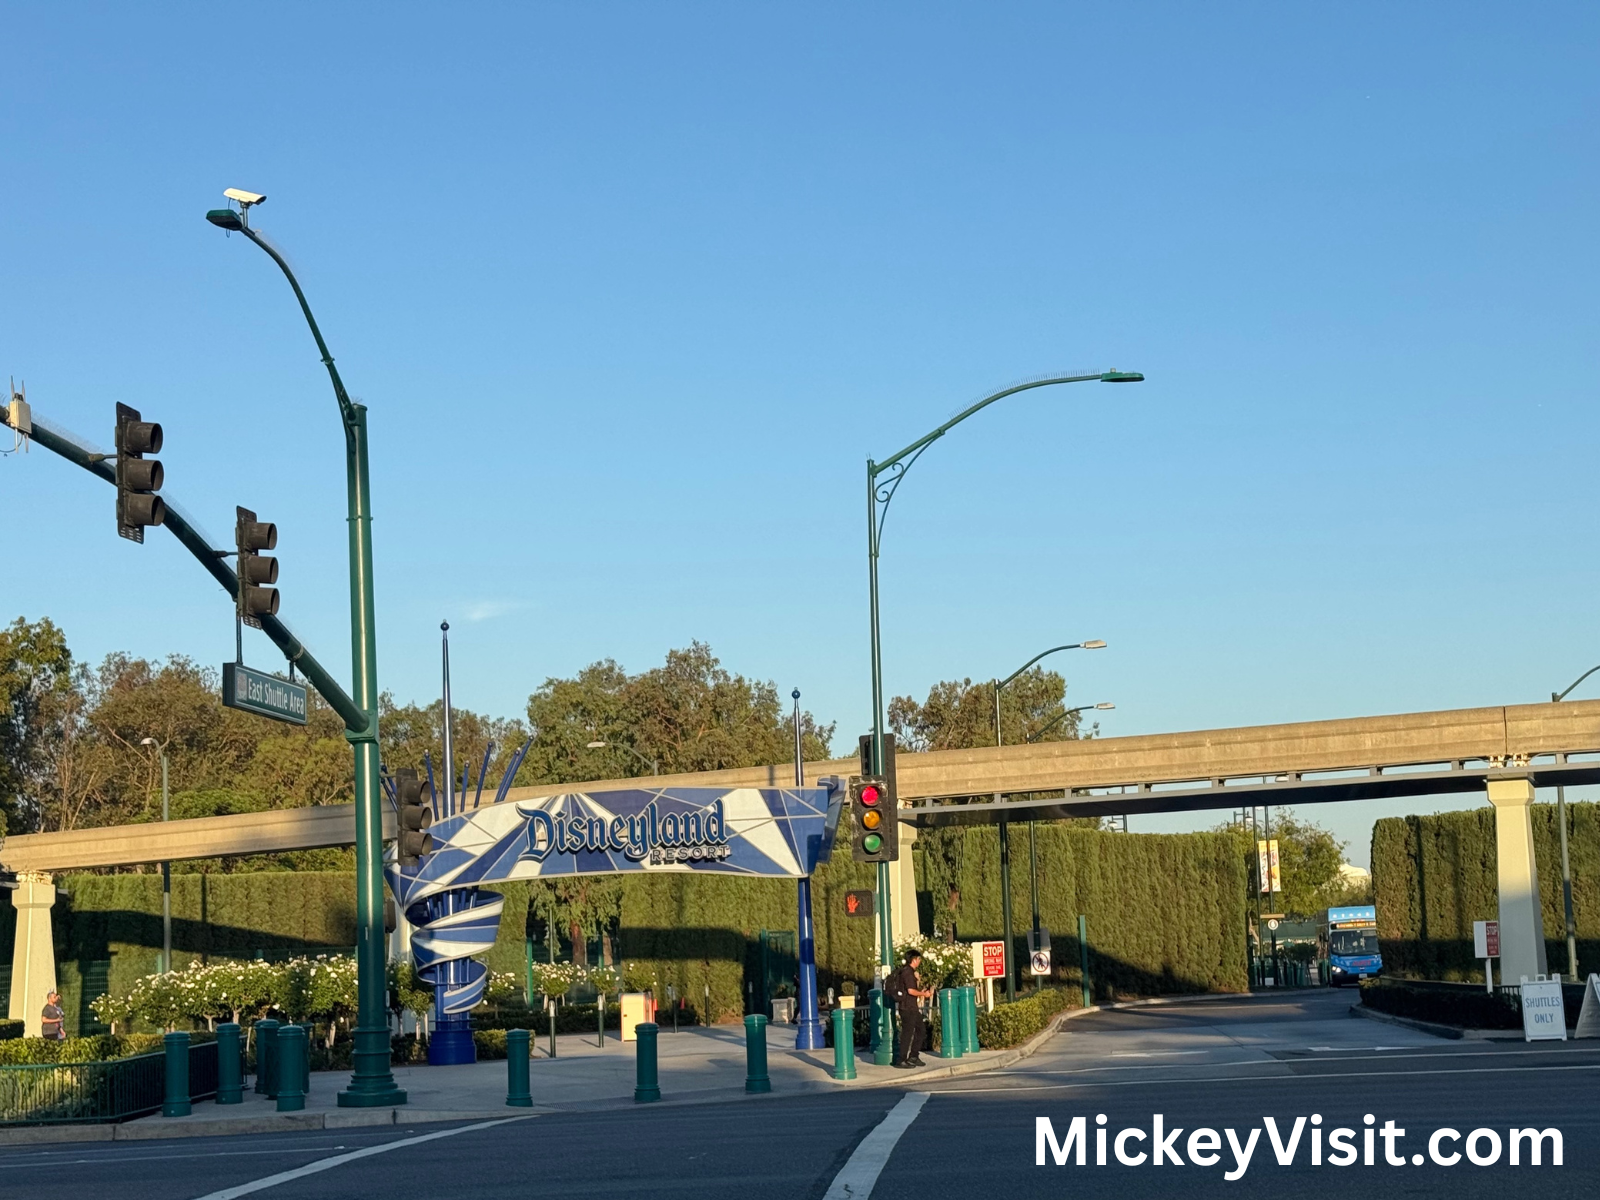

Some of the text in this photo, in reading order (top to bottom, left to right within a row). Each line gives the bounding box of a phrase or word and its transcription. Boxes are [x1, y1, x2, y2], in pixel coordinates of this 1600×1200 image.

[248, 678, 304, 715] East Shuttle Area
[515, 797, 730, 860] Disneyland
[651, 845, 730, 862] RESORT
[984, 946, 1002, 956] STOP
[1525, 997, 1561, 1008] SHUTTLES
[1534, 1013, 1554, 1024] ONLY
